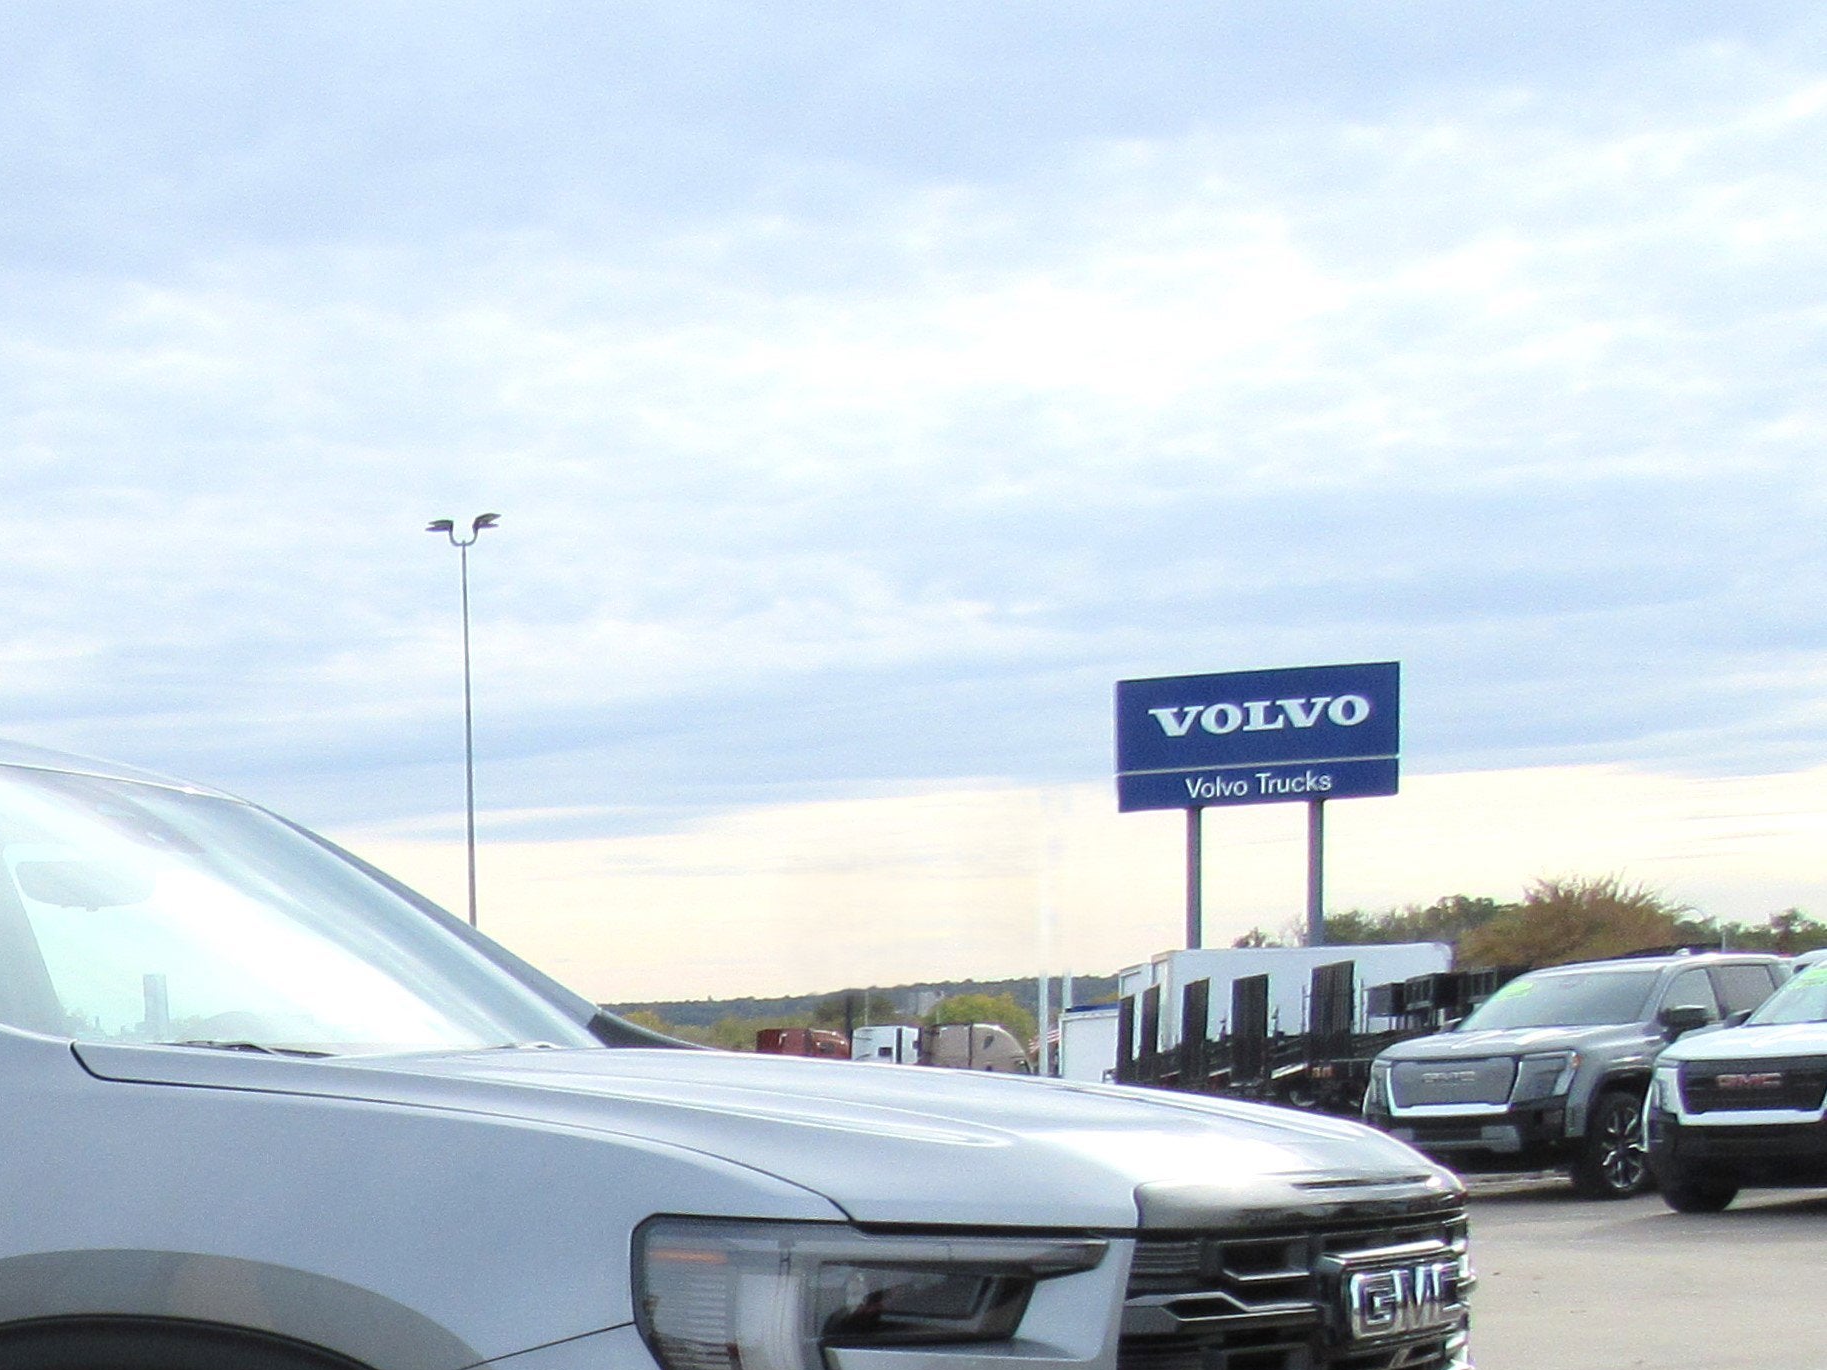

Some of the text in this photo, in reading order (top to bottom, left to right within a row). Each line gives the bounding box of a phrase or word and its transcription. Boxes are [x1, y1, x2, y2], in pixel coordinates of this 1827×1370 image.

[1148, 694, 1370, 737] VOLVO
[1185, 769, 1333, 799] Volvo Trucks
[1715, 1072, 1783, 1089] GMC
[1349, 1260, 1469, 1340] GMC
